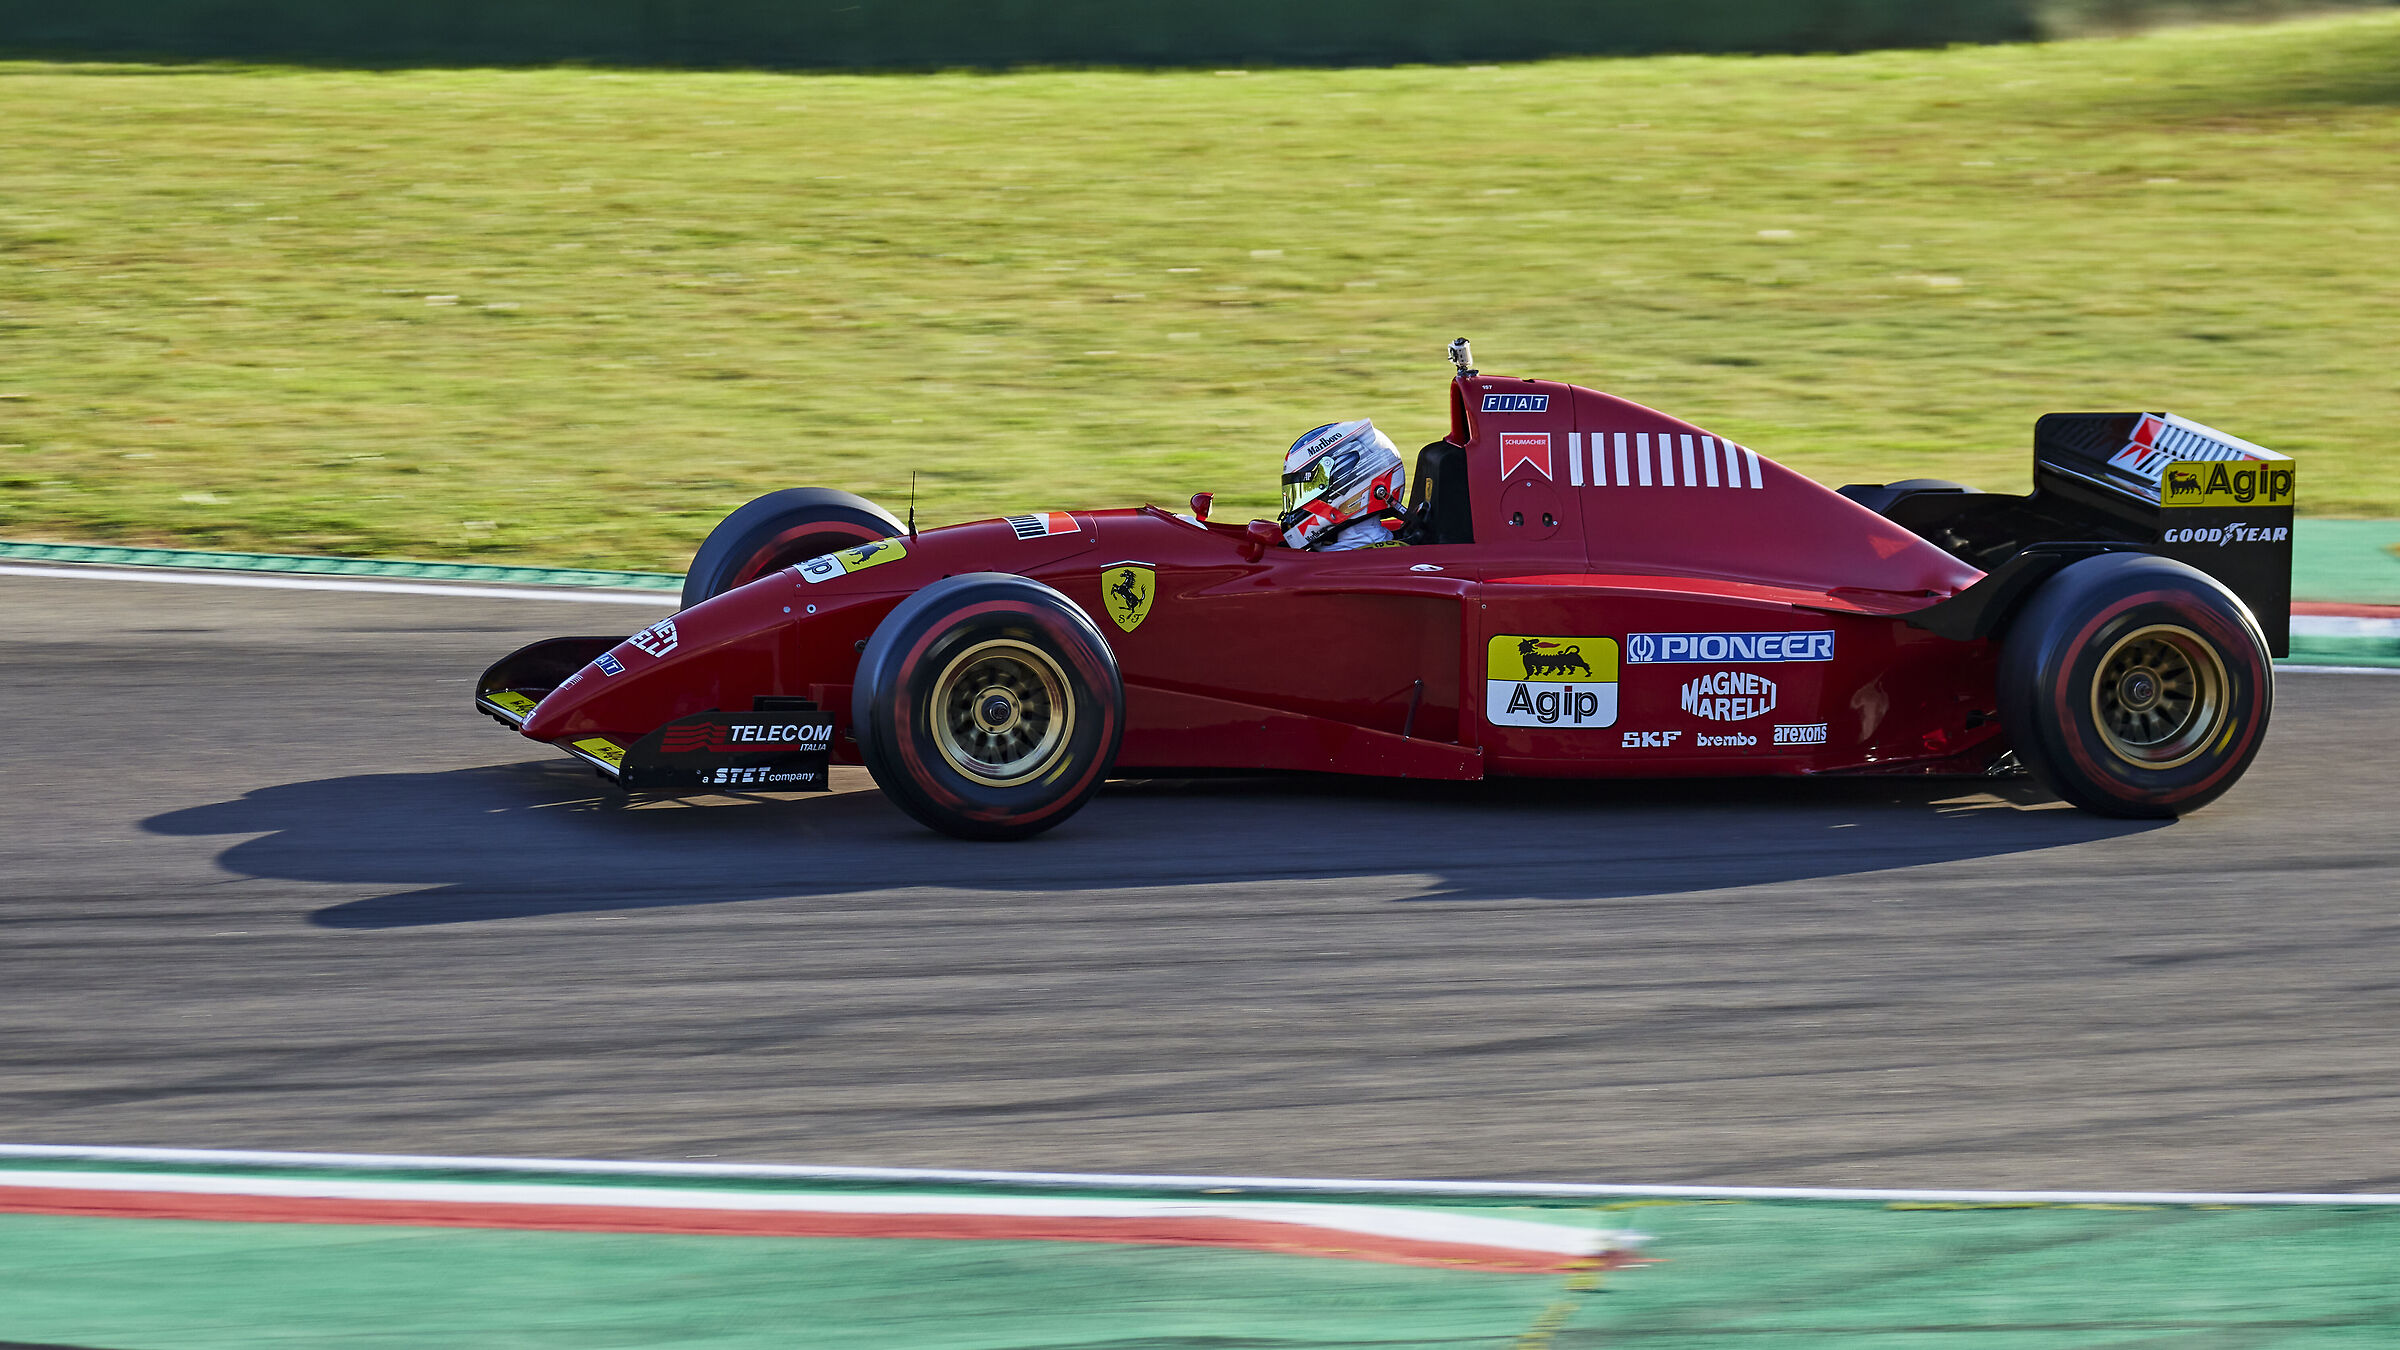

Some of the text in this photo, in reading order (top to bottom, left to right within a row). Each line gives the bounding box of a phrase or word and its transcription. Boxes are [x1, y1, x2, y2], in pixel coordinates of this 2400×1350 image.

[1486, 396, 1546, 410] FIAT
[1306, 431, 1343, 457] Marlboro
[2205, 463, 2292, 503] Agip
[1118, 614, 1126, 624] S
[1661, 635, 1833, 660] PIONEER
[1681, 671, 1777, 699] MAGNETI
[1506, 683, 1599, 724] Agip
[1681, 695, 1777, 721] MARELLI
[731, 725, 833, 742] TELECOM
[1622, 731, 1682, 748] SKF
[1697, 732, 1758, 747] brembo
[1773, 724, 1828, 743] arexons
[799, 743, 827, 751] ITALIA
[702, 766, 815, 784] a STET company
